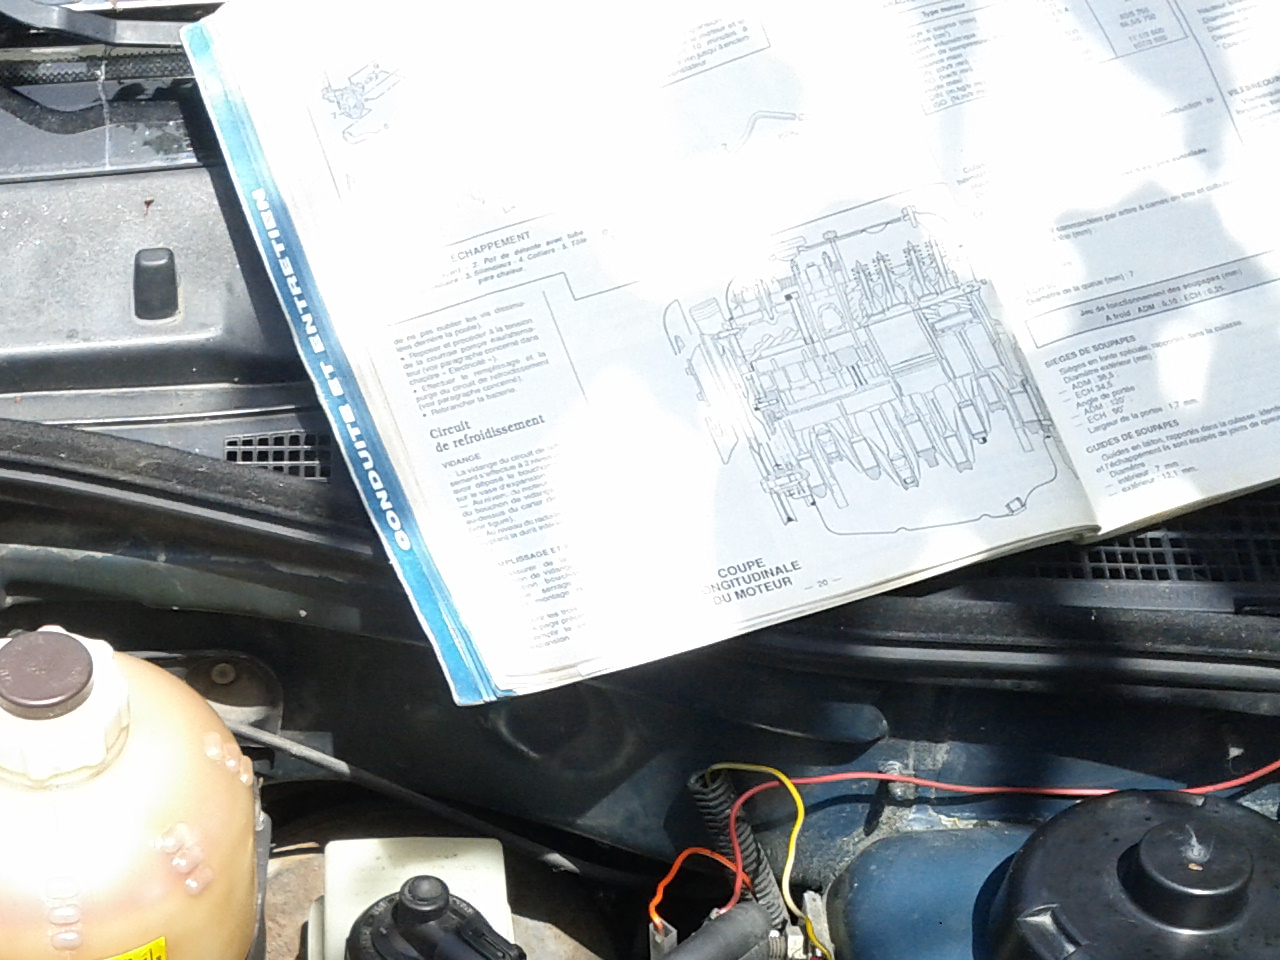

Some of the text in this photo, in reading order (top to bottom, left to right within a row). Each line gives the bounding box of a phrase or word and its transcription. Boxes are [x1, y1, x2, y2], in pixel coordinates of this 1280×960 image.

[1166, 285, 1180, 294] des
[1181, 274, 1220, 290] soupapes
[1137, 290, 1201, 314] ADM ECH
[1078, 334, 1136, 356] DE SOUPAPES
[251, 188, 412, 550] CONDUITE ET ENTRETIEN
[1071, 378, 1092, 391] ADM
[1075, 386, 1095, 399] ECH
[1075, 392, 1111, 410] Angle de
[1083, 403, 1104, 415] ADM
[1086, 411, 1107, 424] ECH
[1120, 415, 1130, 423] de
[429, 420, 471, 439] Circuit
[435, 414, 545, 453] de refroidissement
[1085, 419, 1179, 454] GUIDES DE SOUPAPES
[441, 452, 481, 469] VIDANGE
[1101, 447, 1130, 461] Guides
[1131, 443, 1142, 451] en
[466, 461, 498, 474] vidange
[498, 457, 509, 465] du
[1095, 464, 1105, 474] et
[478, 486, 497, 496] vase
[474, 500, 508, 514] bouchon
[711, 560, 801, 591] ONGITUDINALE
[717, 557, 765, 578] COUPE
[712, 576, 792, 605] DU MOTEUR
[816, 578, 829, 587] 20
